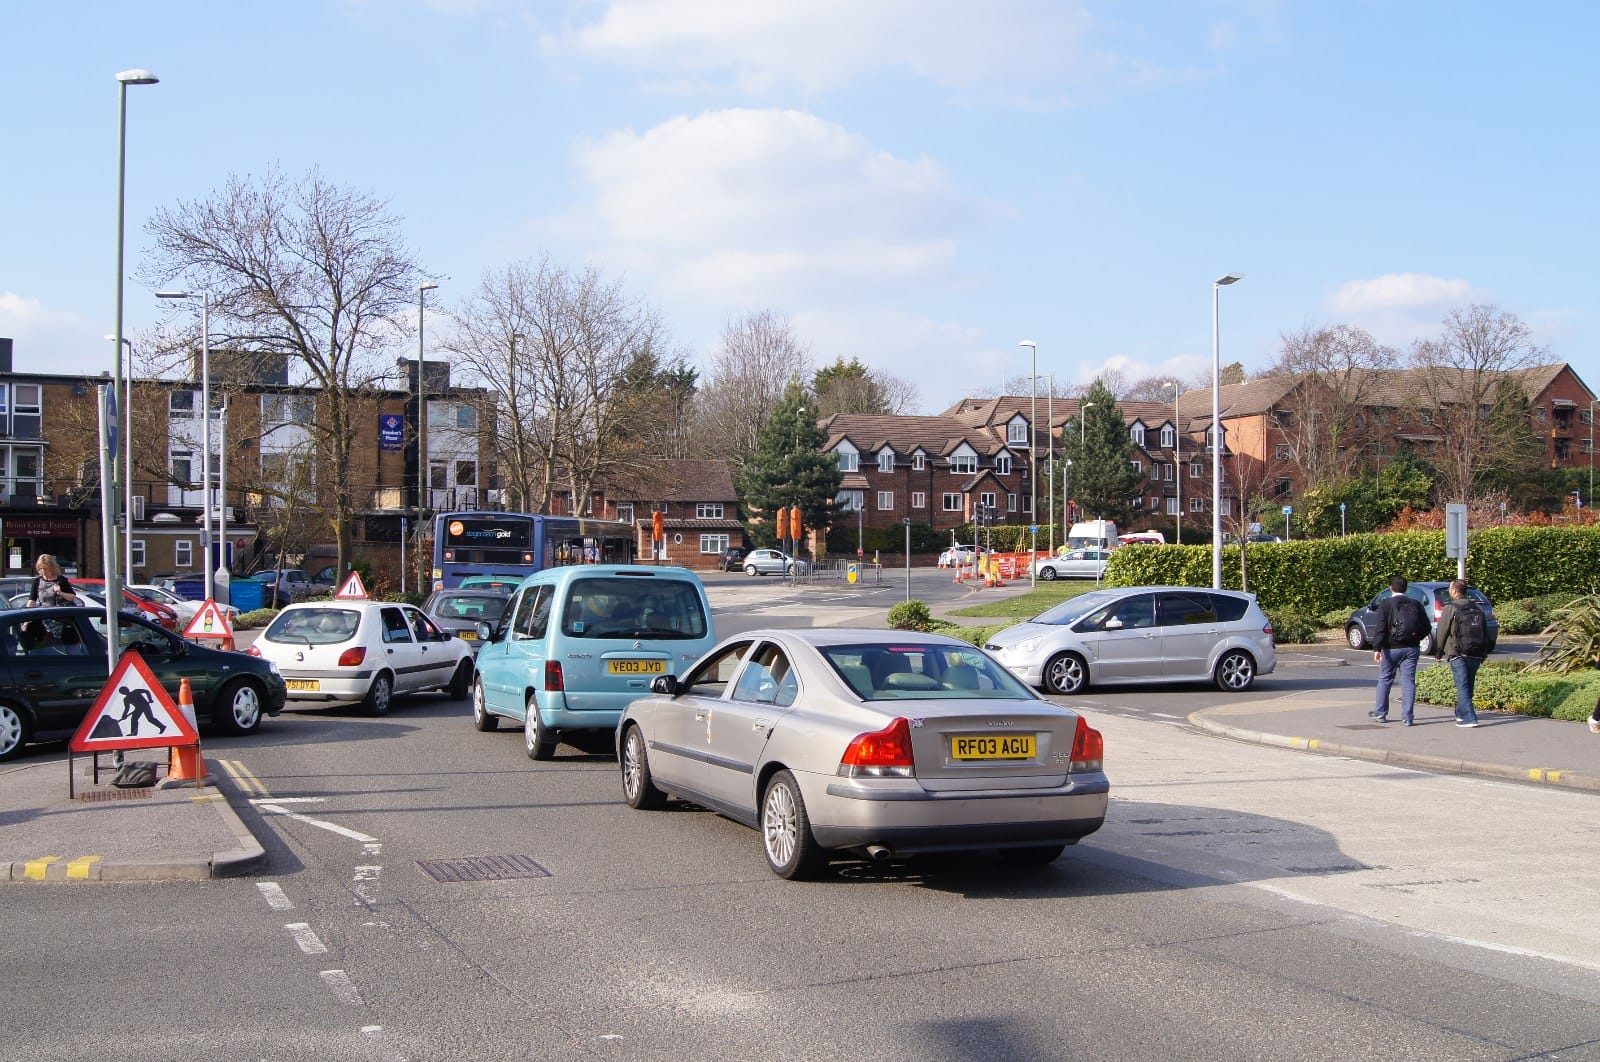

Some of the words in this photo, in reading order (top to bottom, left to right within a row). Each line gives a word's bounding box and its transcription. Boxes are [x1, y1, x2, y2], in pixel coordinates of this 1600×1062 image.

[496, 530, 512, 539] gold
[612, 661, 639, 672] VE03
[641, 662, 661, 672] JYD
[958, 739, 998, 755] RF03
[1001, 739, 1030, 754] AGU
